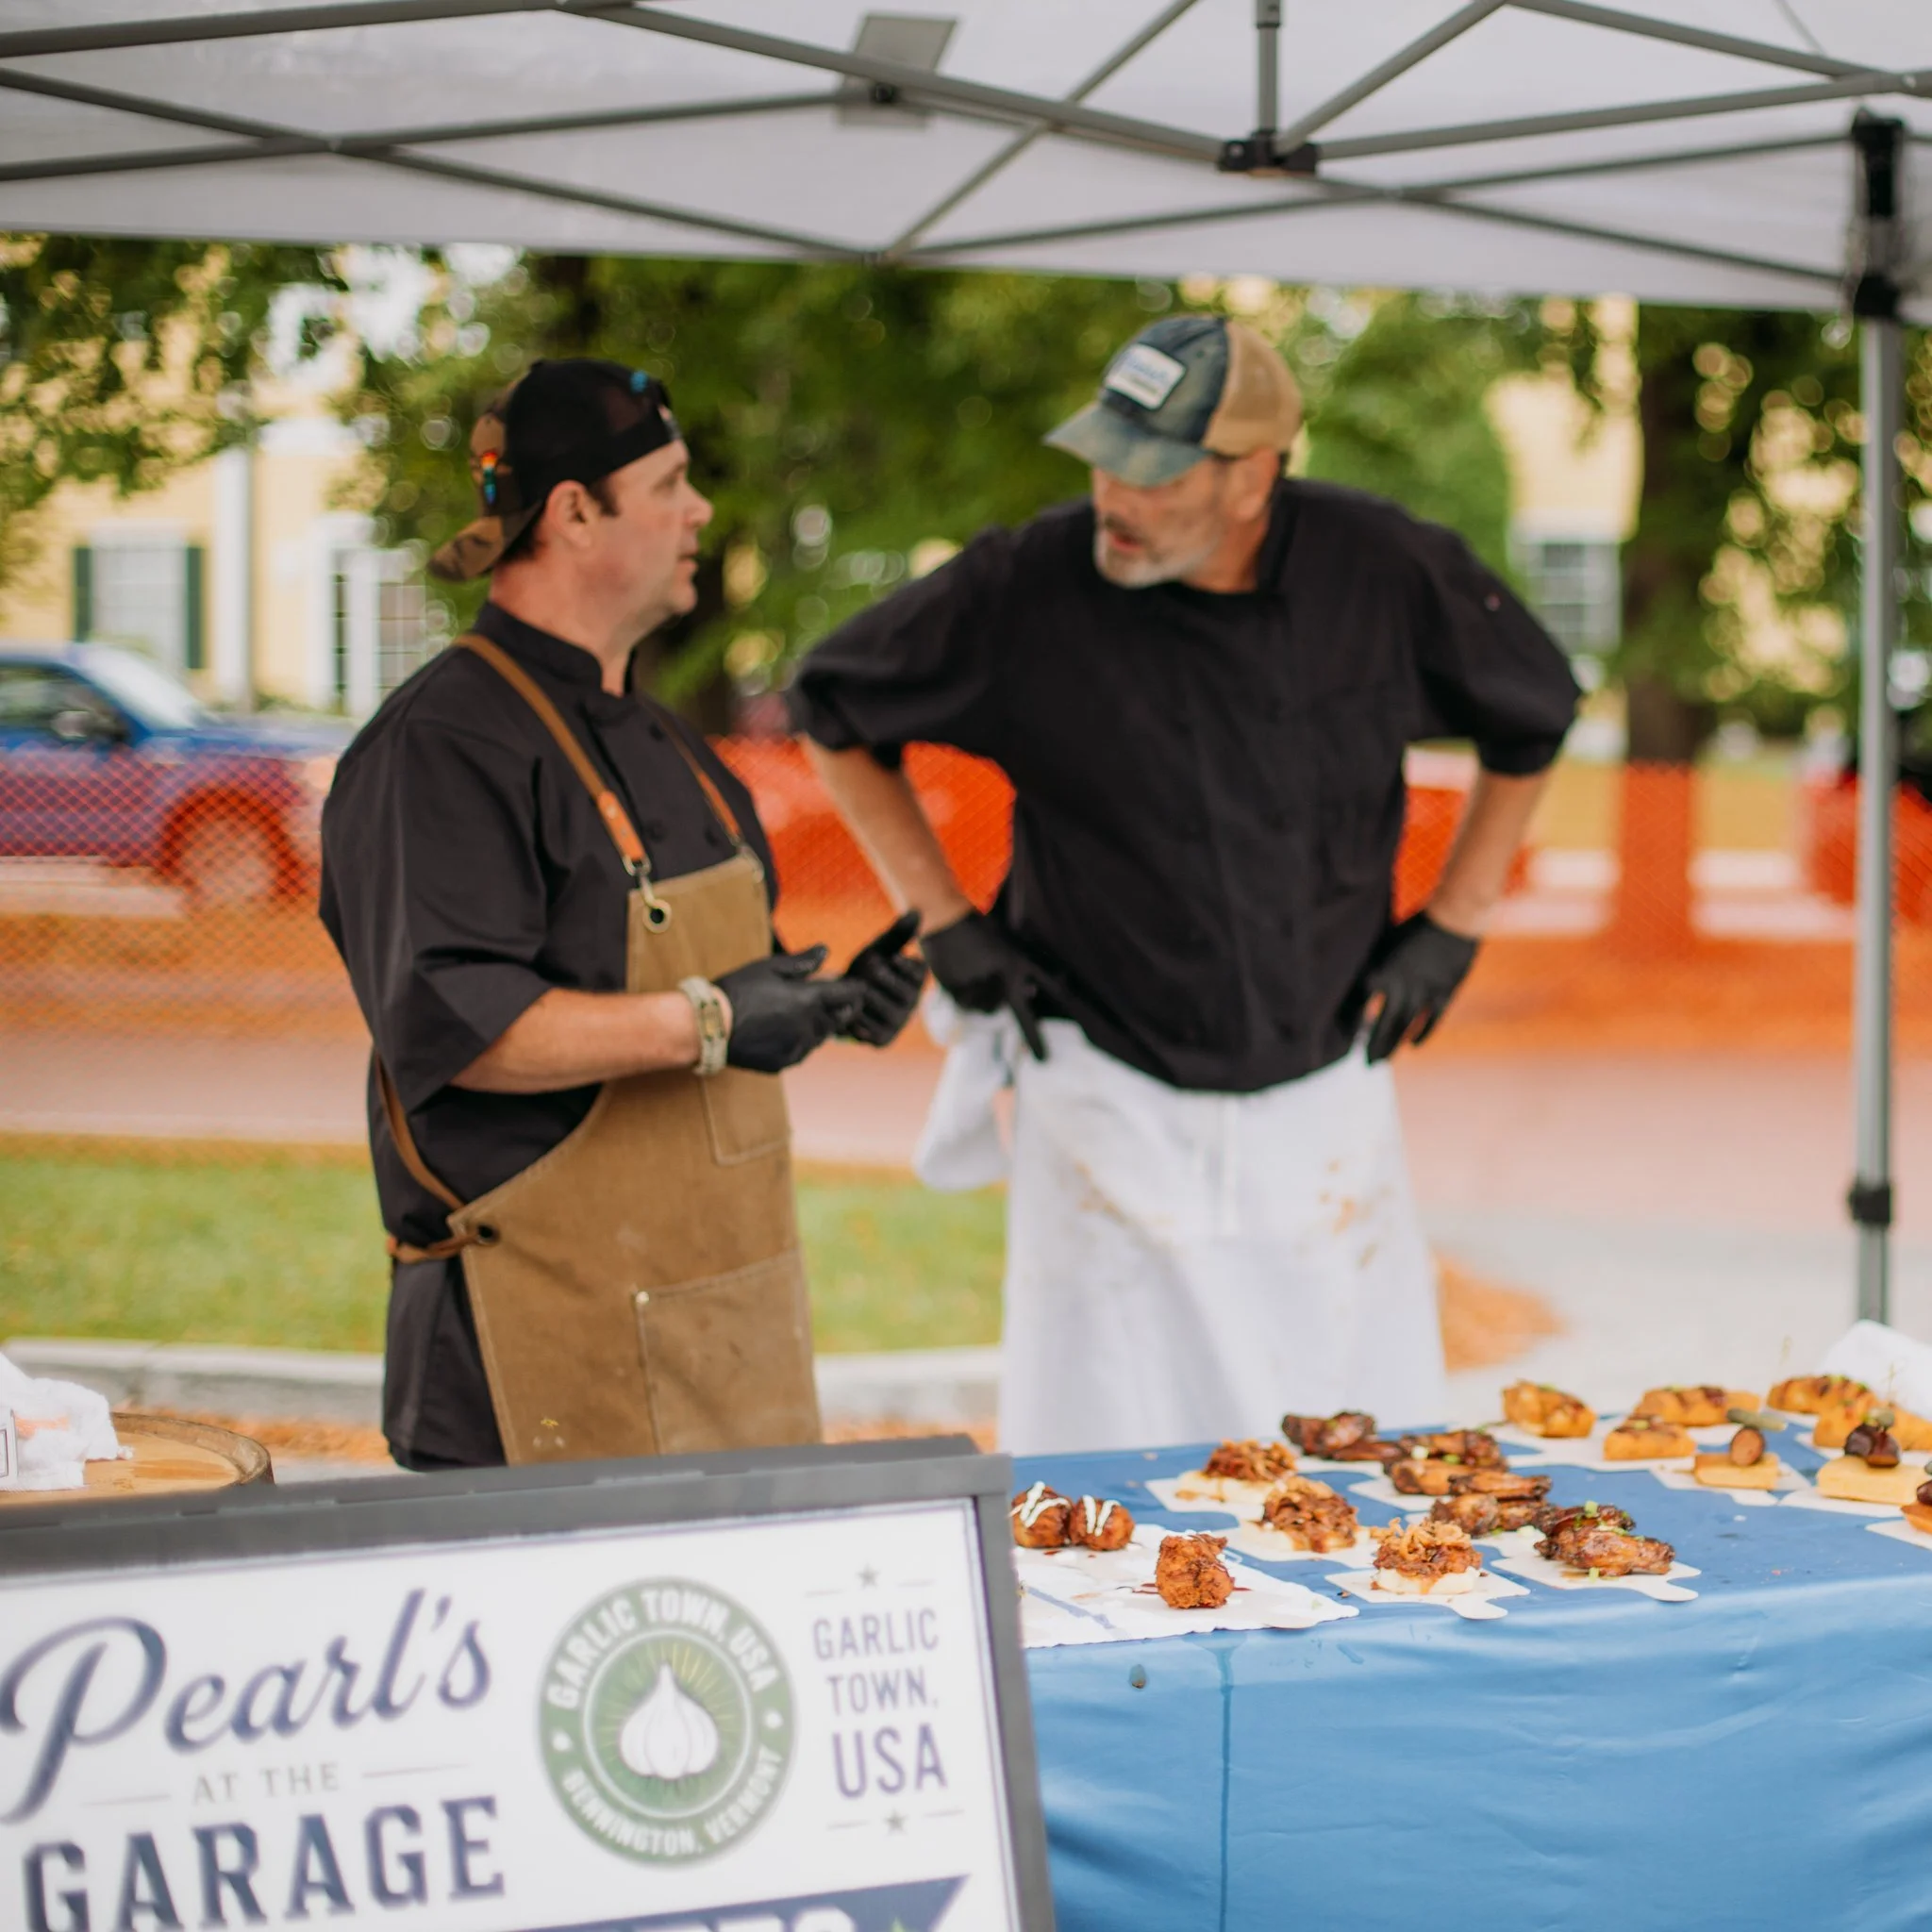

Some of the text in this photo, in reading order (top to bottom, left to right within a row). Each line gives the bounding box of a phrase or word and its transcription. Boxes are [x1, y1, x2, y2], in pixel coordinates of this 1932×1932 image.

[545, 1595, 637, 1709] GARLIC
[728, 1625, 778, 1693] USA
[812, 1607, 940, 1661] GARLIC
[0, 1588, 491, 1825] Pearl's
[192, 1761, 340, 1806] AT THE
[831, 1722, 948, 1800] USA
[22, 1794, 506, 1932] GARAGE
